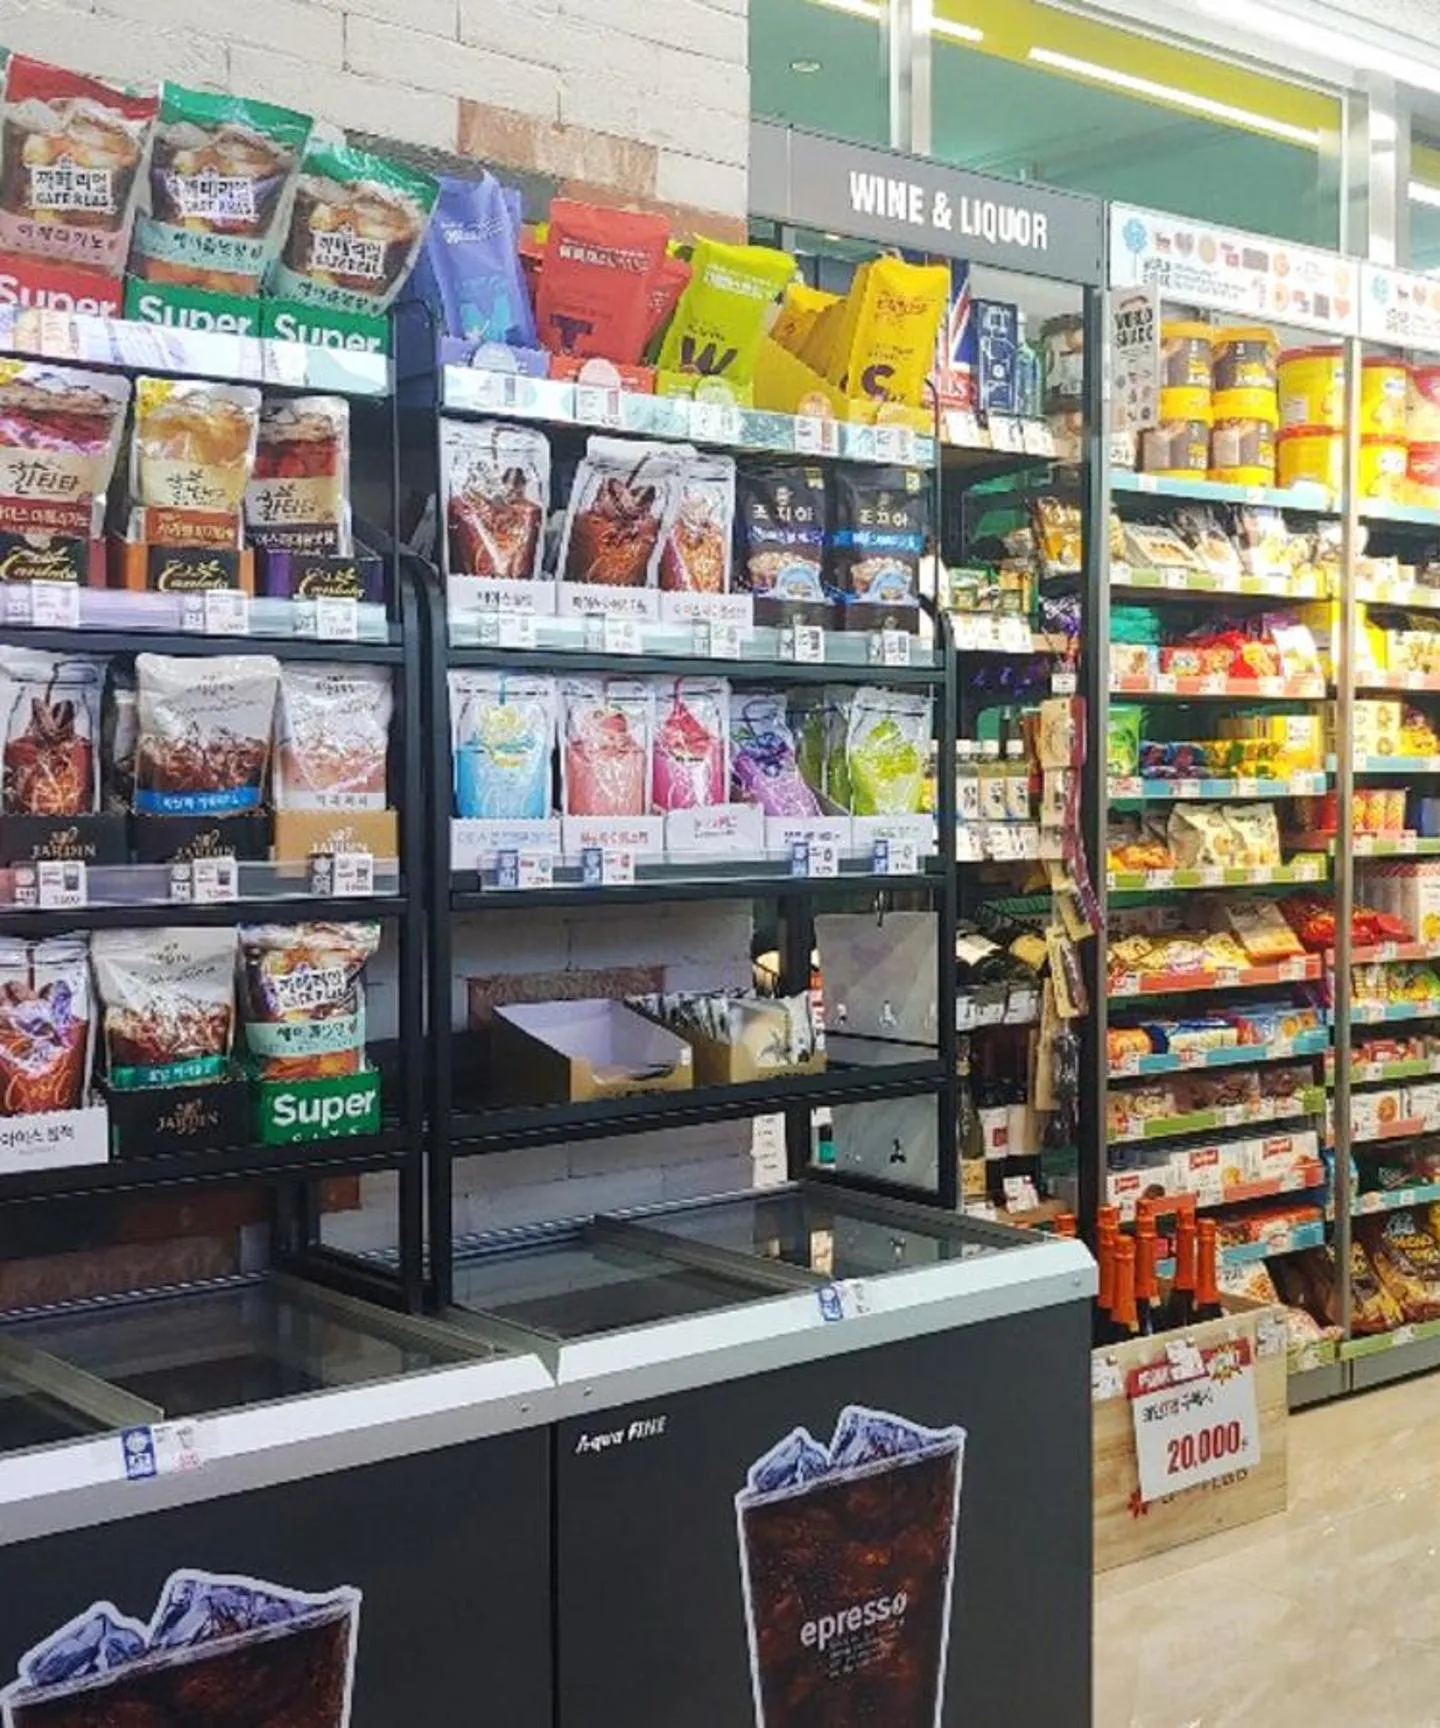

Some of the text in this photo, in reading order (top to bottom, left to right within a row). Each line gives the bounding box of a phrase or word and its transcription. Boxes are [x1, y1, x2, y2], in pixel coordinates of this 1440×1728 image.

[850, 171, 1048, 250] WINE & LIQUOR
[139, 295, 253, 335] Super
[273, 312, 382, 356] Super
[272, 1088, 377, 1128] Super
[1166, 1420, 1240, 1475] 20,000
[800, 1590, 908, 1651] epresso
